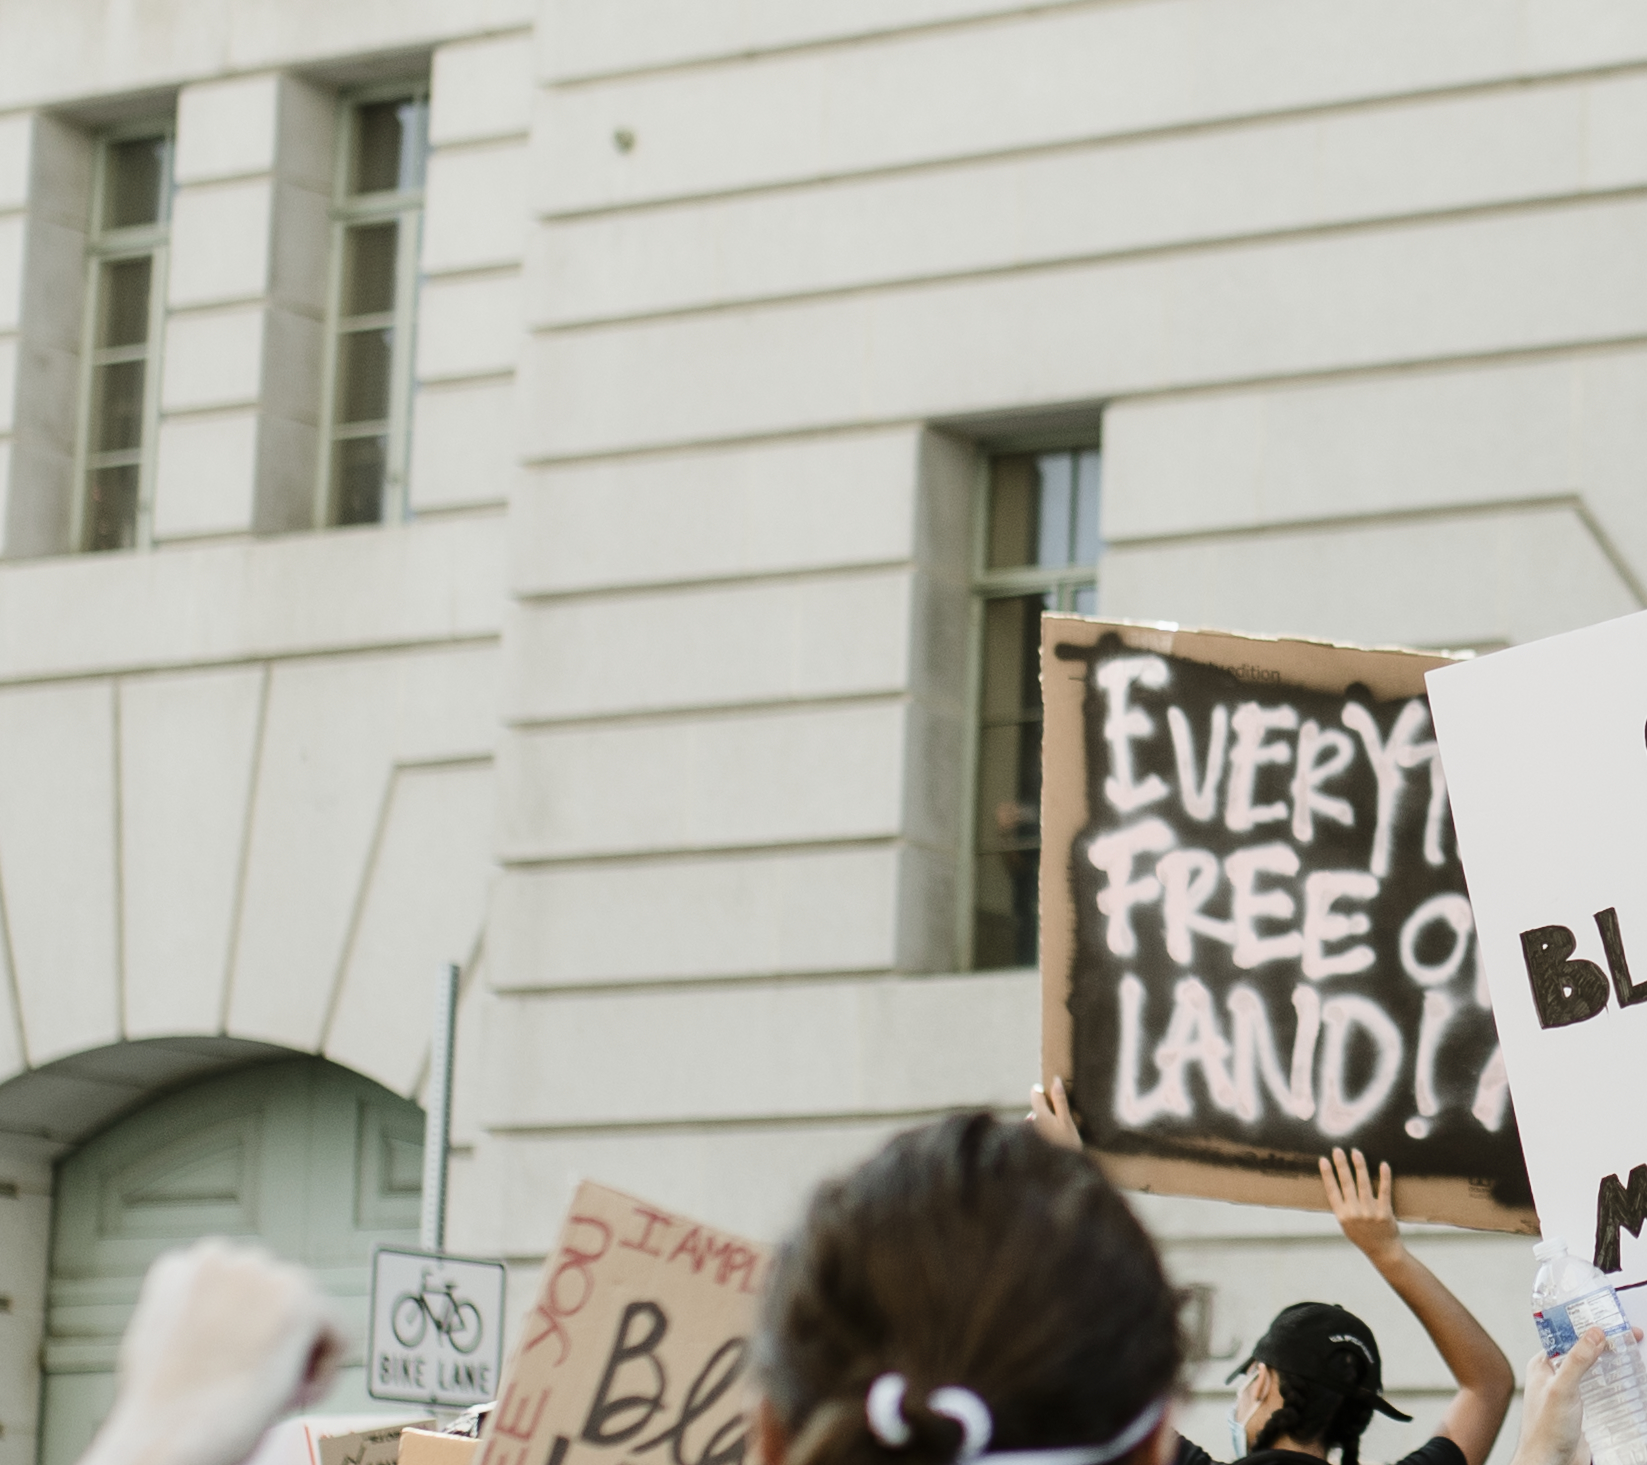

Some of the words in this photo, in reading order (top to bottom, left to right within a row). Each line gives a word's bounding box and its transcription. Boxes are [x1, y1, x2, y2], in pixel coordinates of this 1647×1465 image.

[1086, 817, 1380, 981] FREE
[523, 1214, 614, 1368] YOU
[380, 1353, 426, 1388] BIKE
[438, 1359, 490, 1395] LANE
